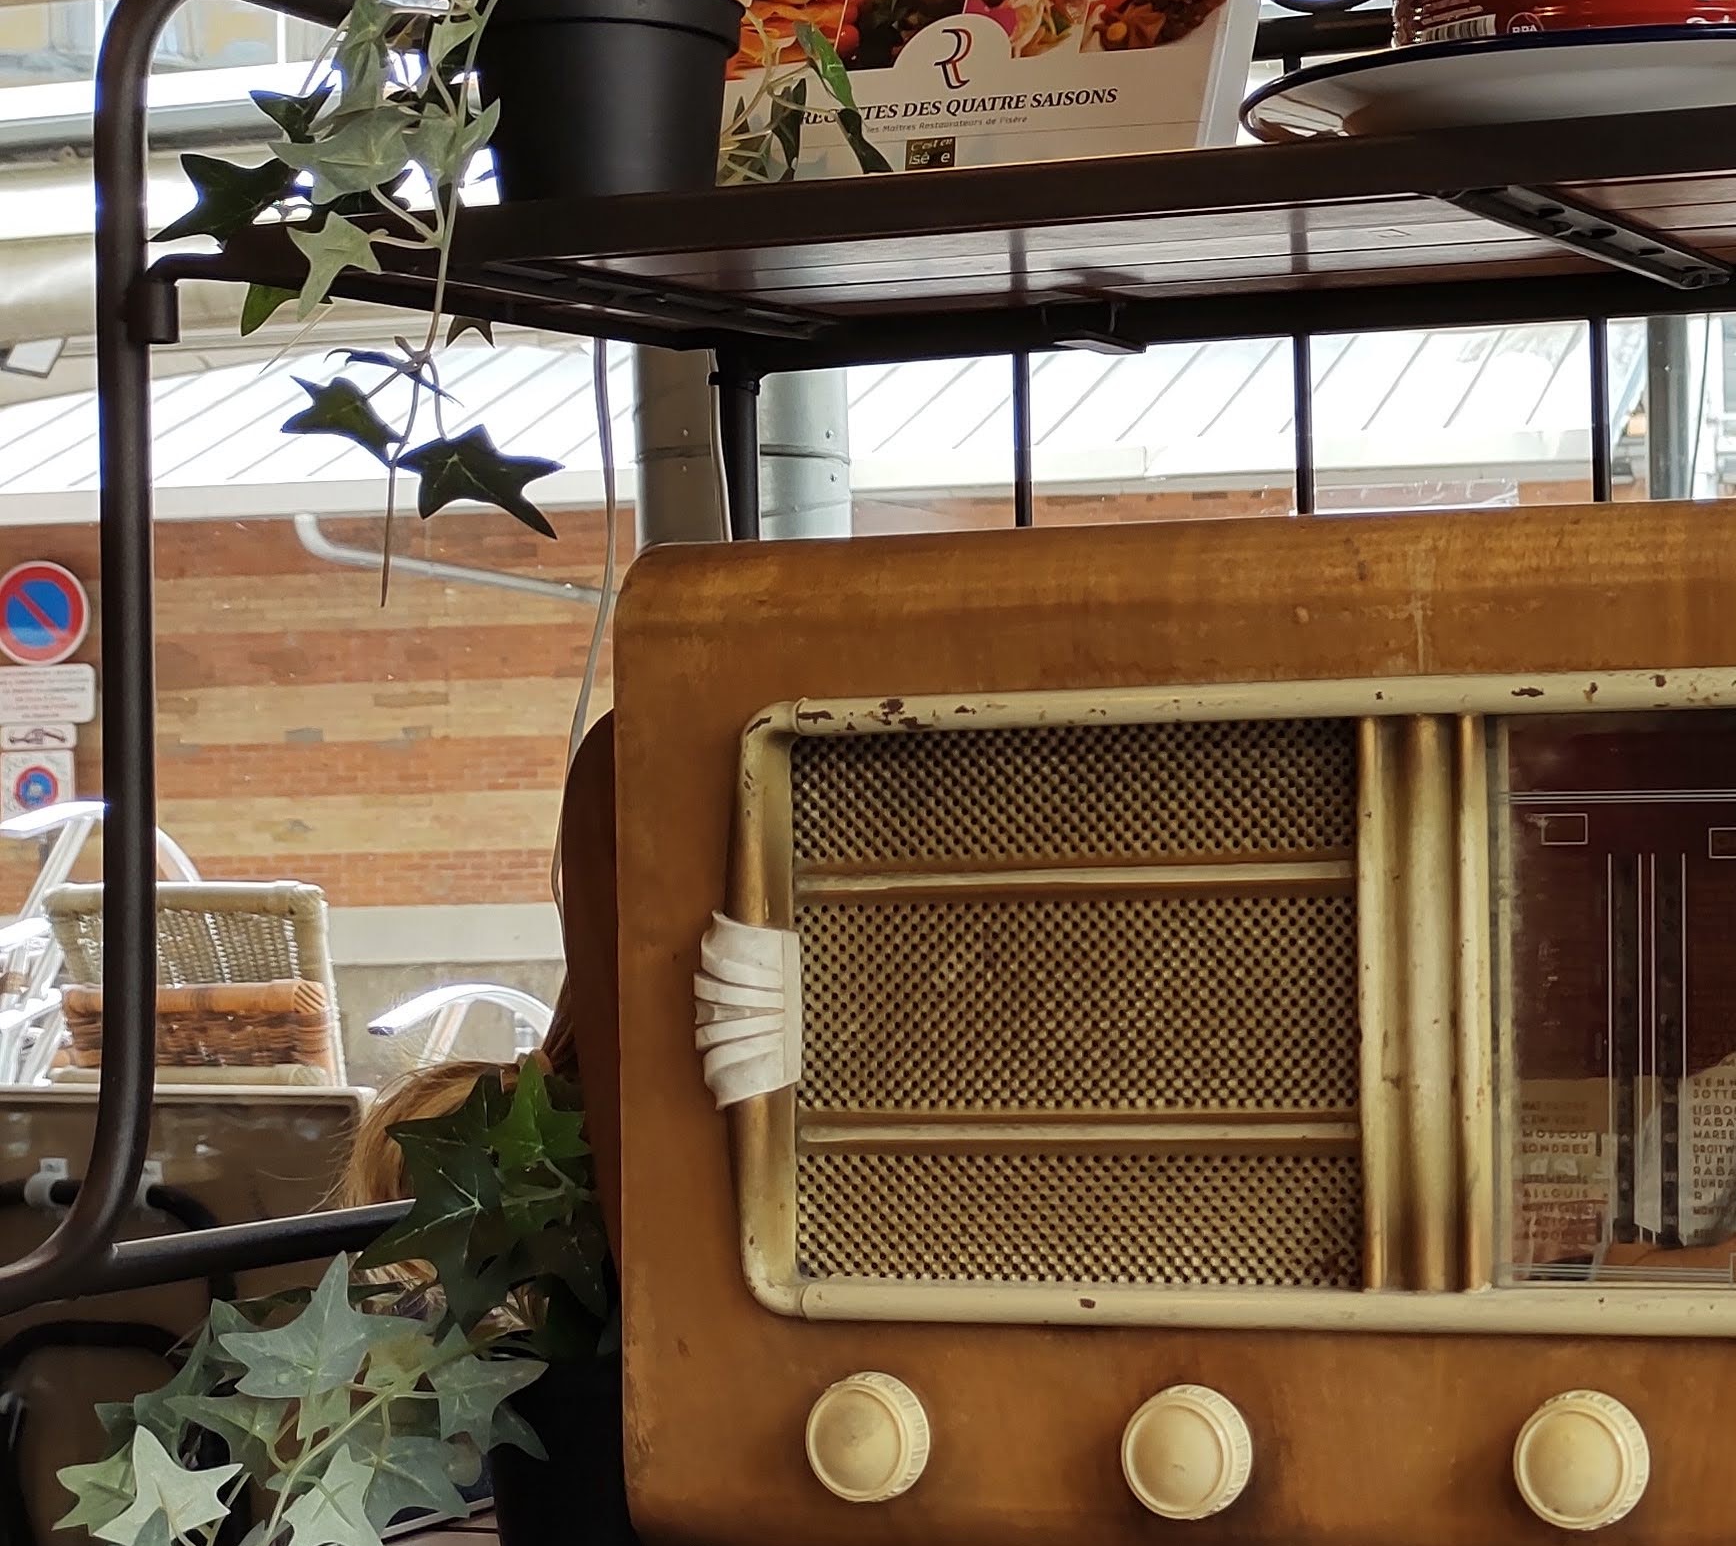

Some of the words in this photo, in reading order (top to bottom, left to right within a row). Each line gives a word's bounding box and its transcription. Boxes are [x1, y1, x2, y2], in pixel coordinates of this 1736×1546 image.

[902, 100, 943, 120] DES
[946, 94, 1027, 117] QUATRE
[1030, 88, 1118, 109] SAISONS
[1521, 1143, 1589, 1154] LONDRES
